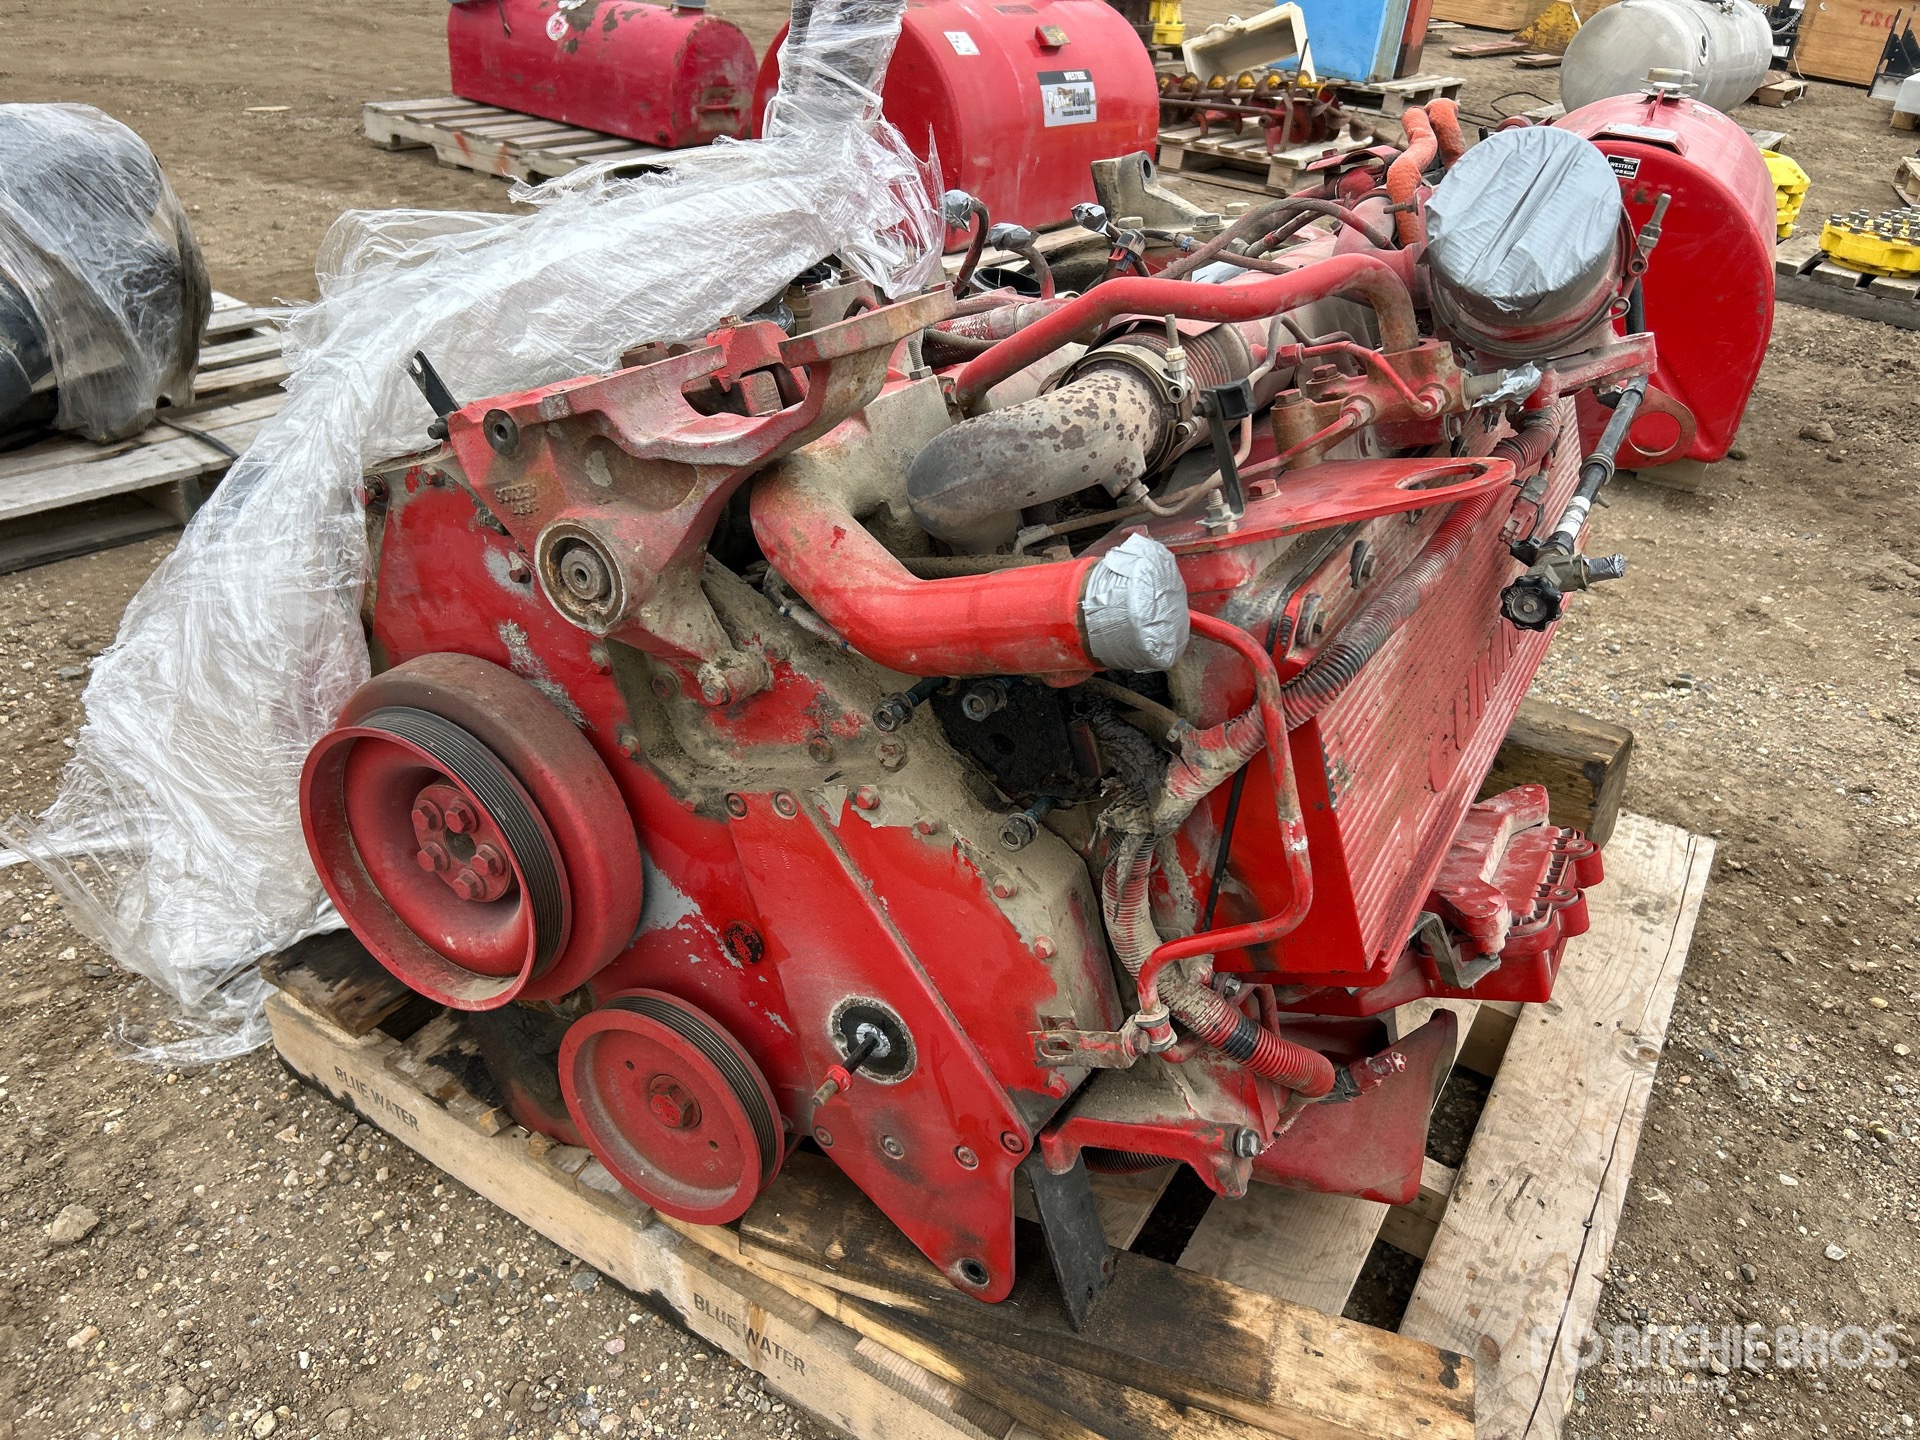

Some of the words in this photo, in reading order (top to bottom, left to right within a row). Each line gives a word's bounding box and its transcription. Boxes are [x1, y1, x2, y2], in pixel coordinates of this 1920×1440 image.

[334, 1065, 369, 1100] BLUE
[370, 1088, 420, 1132] WATER
[693, 1292, 740, 1338] BLUE
[742, 1323, 806, 1378] WATER
